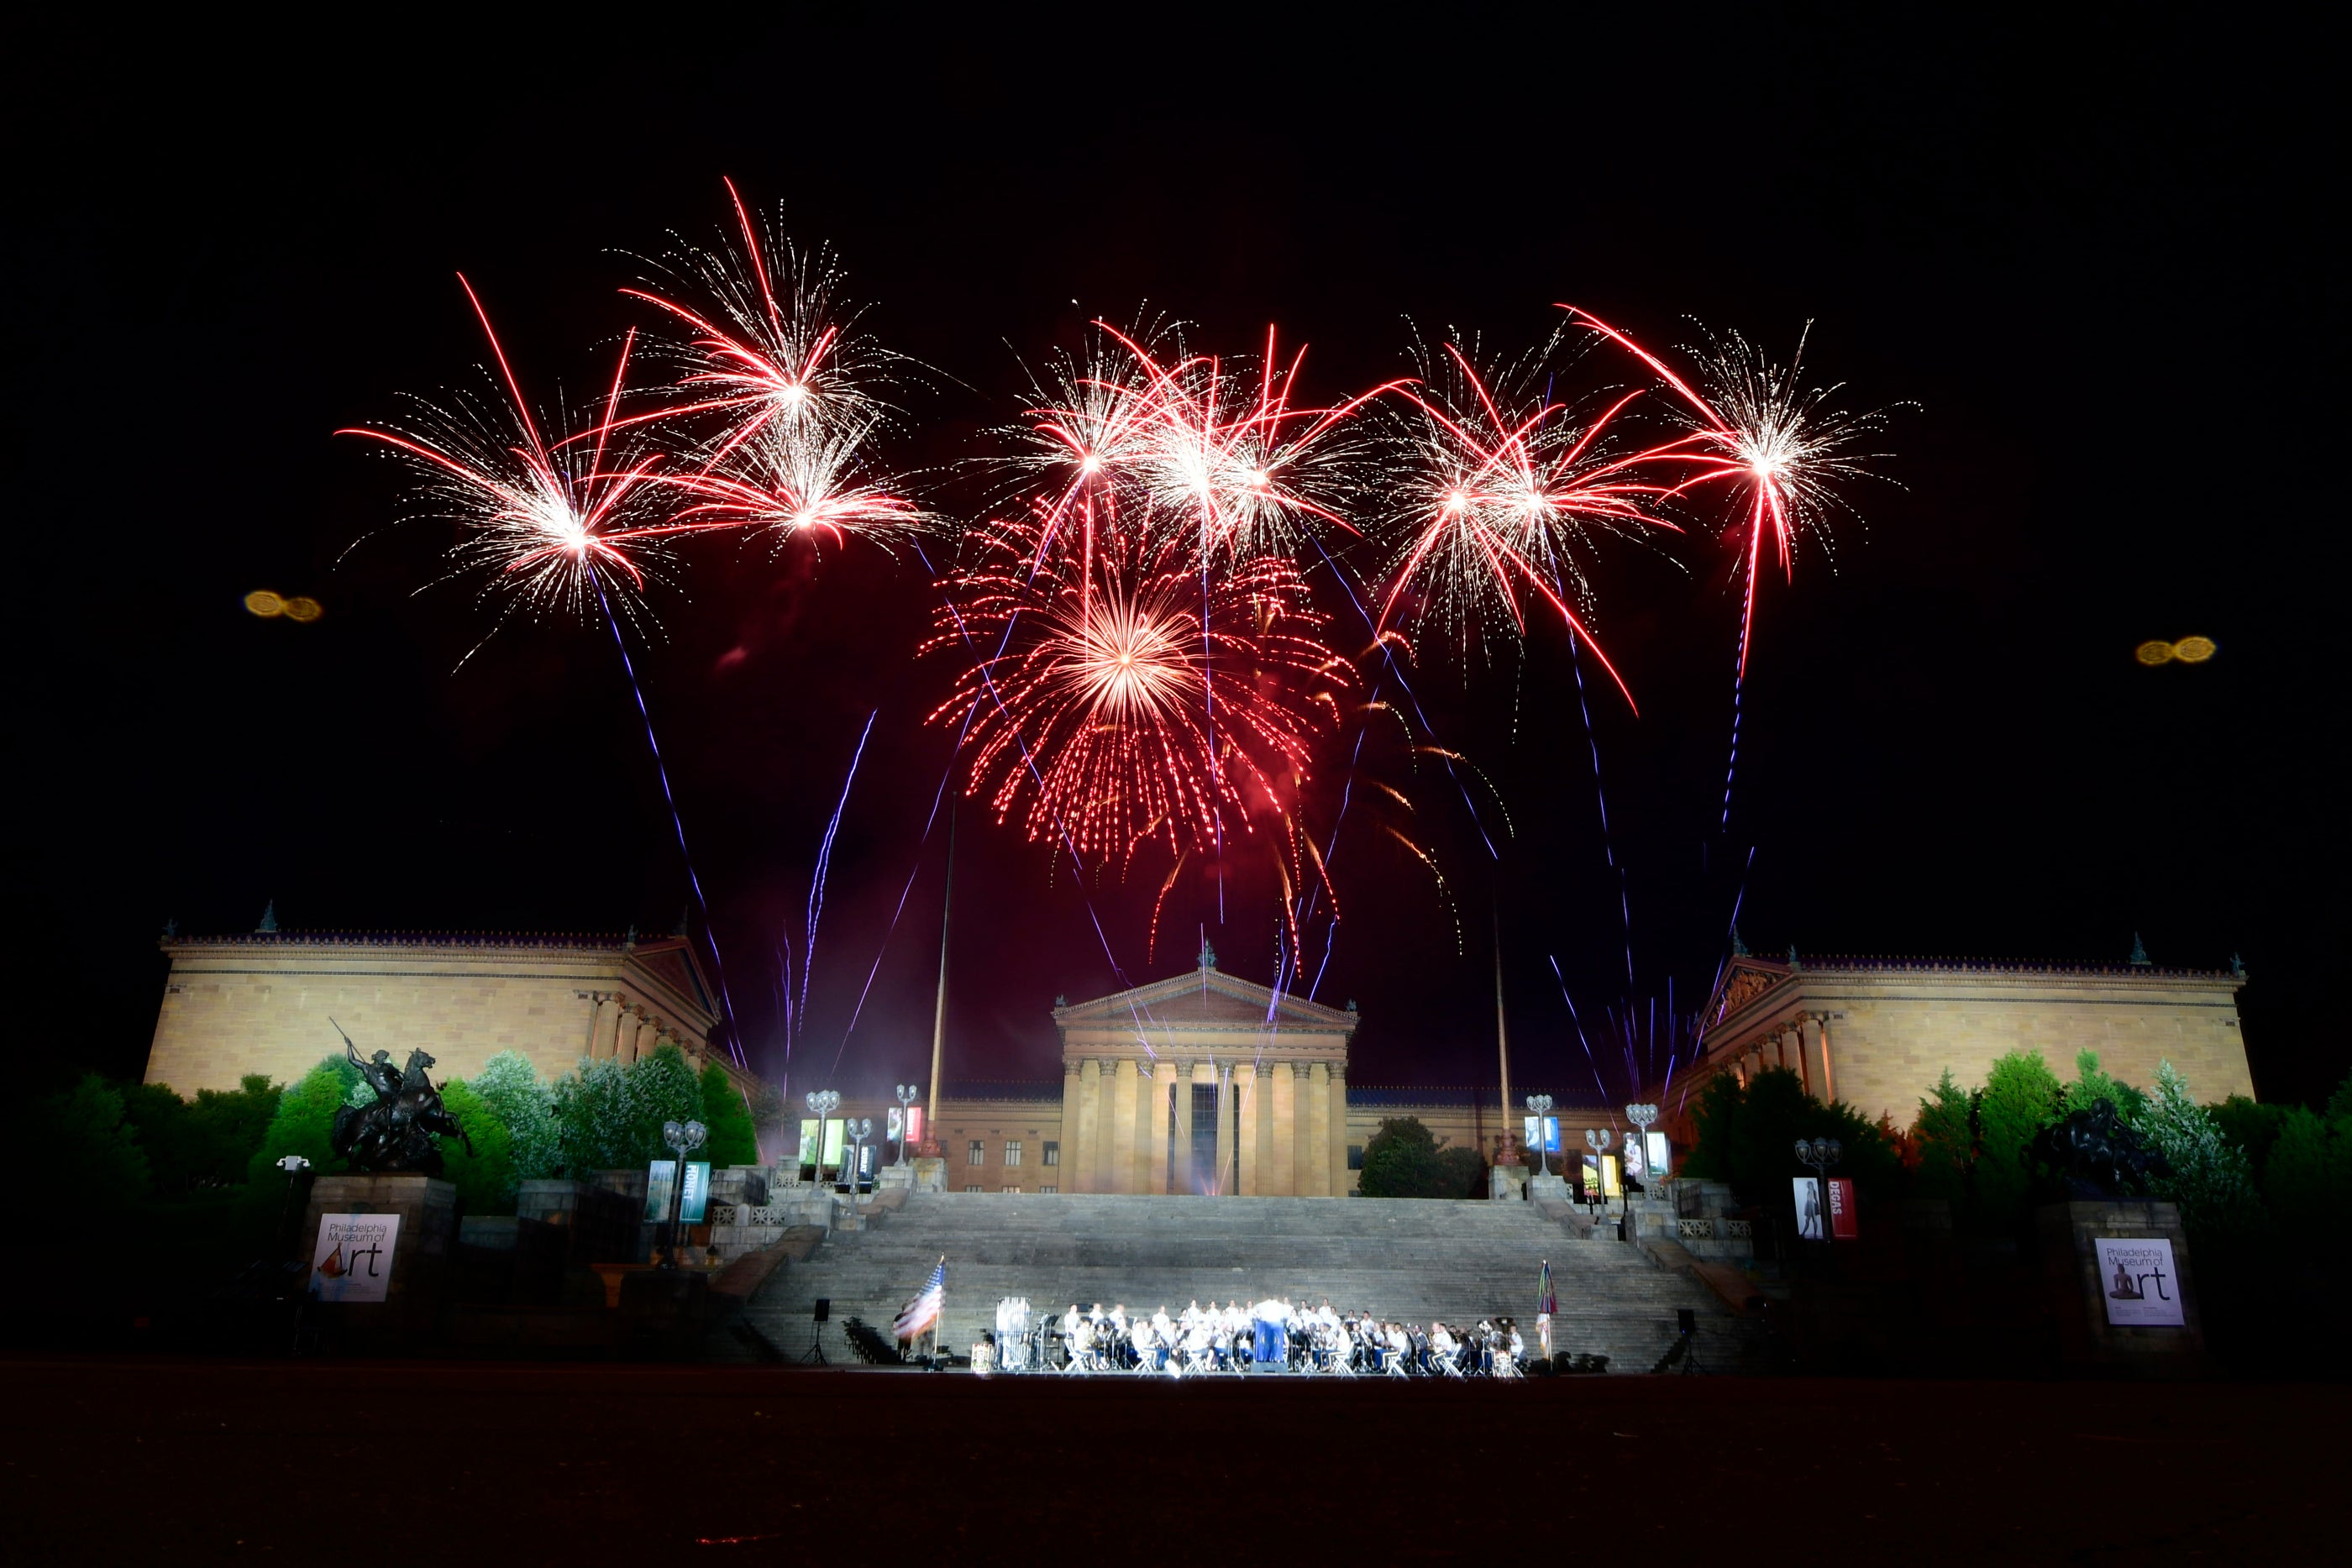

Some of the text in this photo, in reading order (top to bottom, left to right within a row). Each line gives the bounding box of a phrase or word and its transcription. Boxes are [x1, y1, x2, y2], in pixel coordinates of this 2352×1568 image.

[683, 1164, 697, 1201] MONET
[1830, 1181, 1842, 1214] DEGAS
[329, 1224, 386, 1235] Philadelphia
[328, 1232, 386, 1242] Museum of
[2107, 1248, 2163, 1258] Philadelphia
[2108, 1256, 2164, 1266] Museum of
